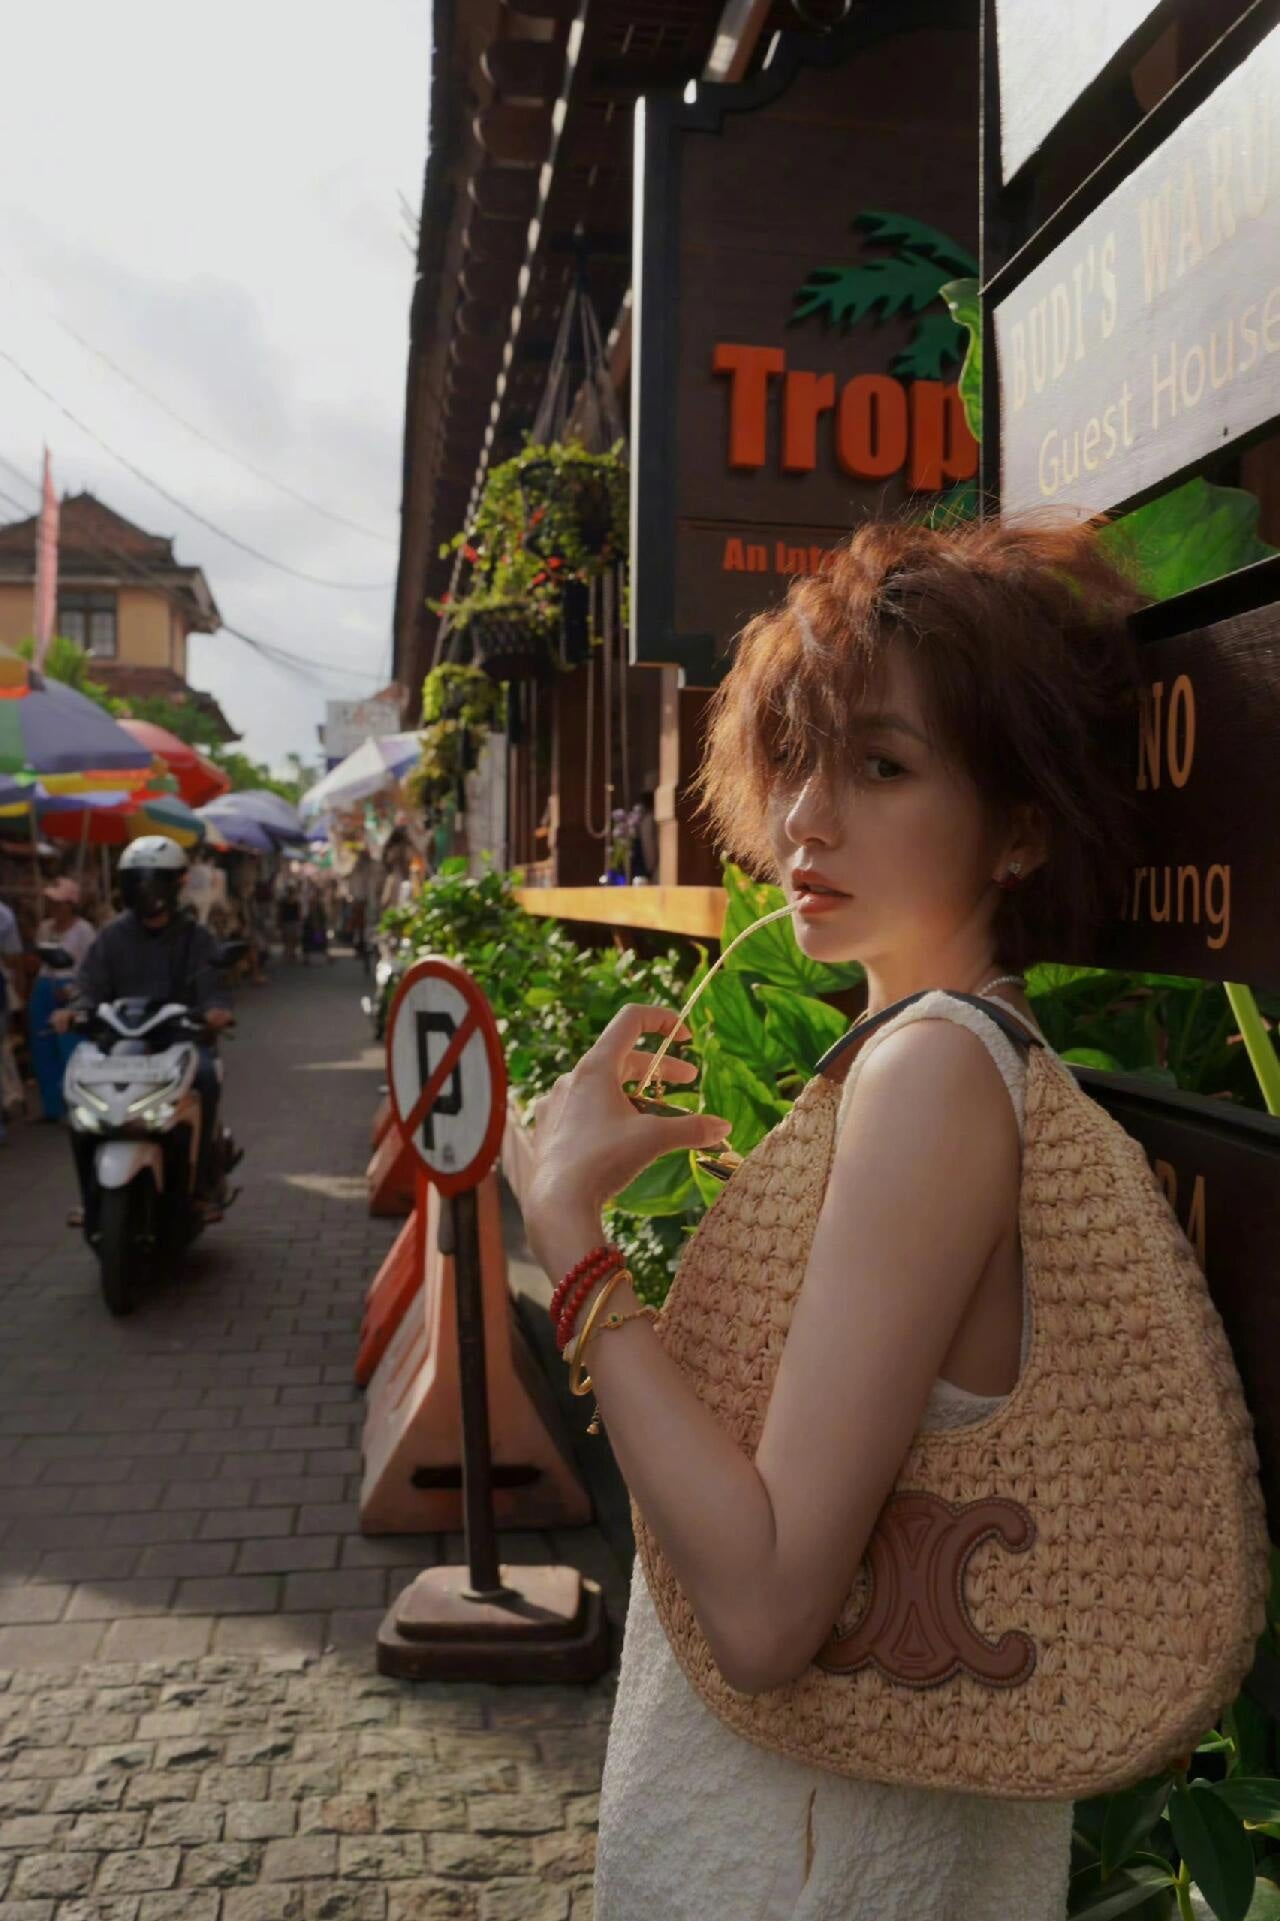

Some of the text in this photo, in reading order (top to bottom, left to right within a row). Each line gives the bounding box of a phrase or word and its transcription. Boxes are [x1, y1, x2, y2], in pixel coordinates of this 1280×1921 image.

[1010, 230, 1118, 412] BUDI'S
[1037, 285, 1280, 497] Guest House
[712, 343, 980, 492] Trop
[723, 538, 768, 571] An
[1120, 862, 1232, 951] rung
